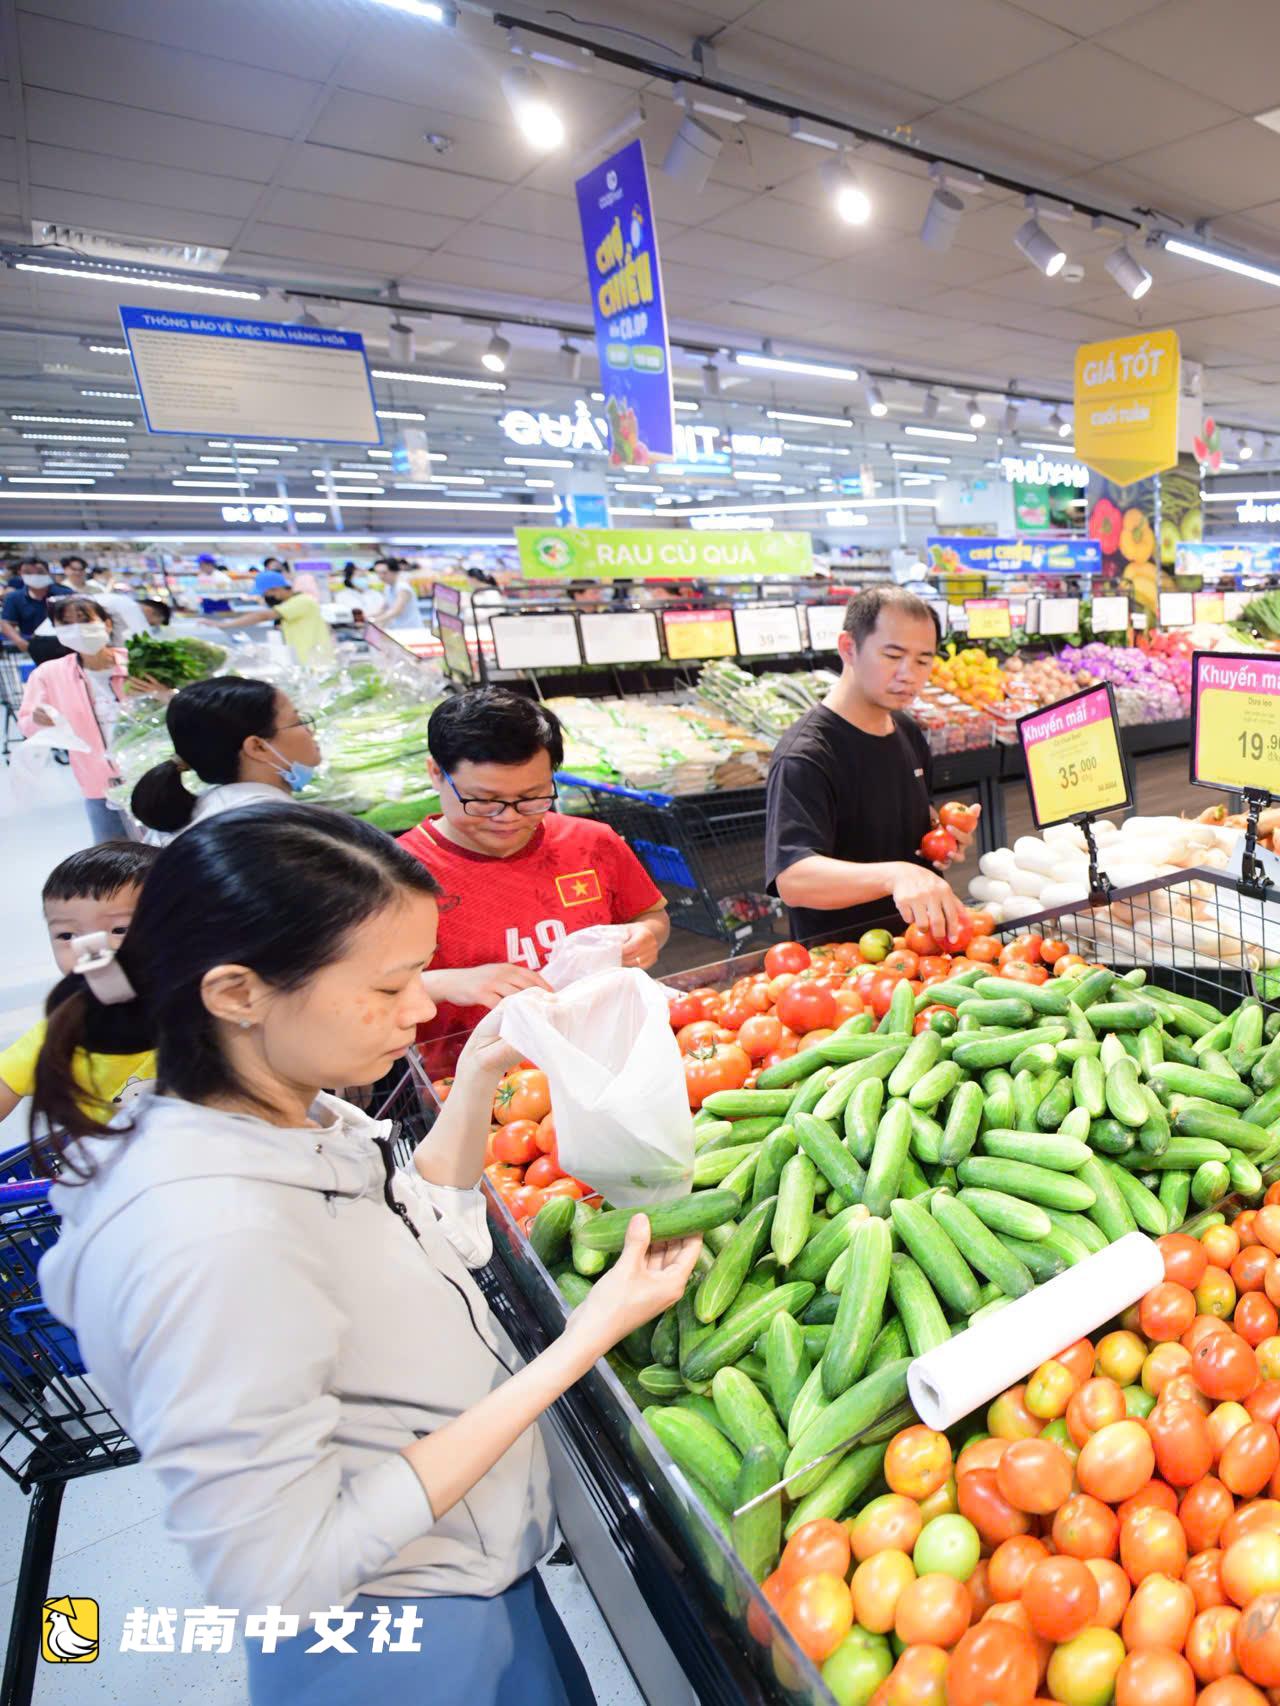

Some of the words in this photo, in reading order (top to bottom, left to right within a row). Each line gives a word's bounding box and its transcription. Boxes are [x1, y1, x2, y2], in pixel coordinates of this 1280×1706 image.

[142, 314, 189, 329] THÔNG
[190, 319, 217, 332] BÁO
[235, 325, 262, 338] VIỆC
[264, 325, 287, 340] TRẢ
[1082, 352, 1117, 387] GIÁ
[1121, 341, 1165, 382] TỐT
[597, 545, 652, 566] RAU
[659, 539, 698, 566] CỦ
[703, 540, 757, 566] QUẢ
[1200, 664, 1257, 689] Khuyến
[1024, 714, 1064, 743] Khuyến
[1065, 702, 1088, 727] mãi
[1238, 731, 1263, 761] 19
[1059, 763, 1079, 790] 35
[505, 918, 568, 970] 49
